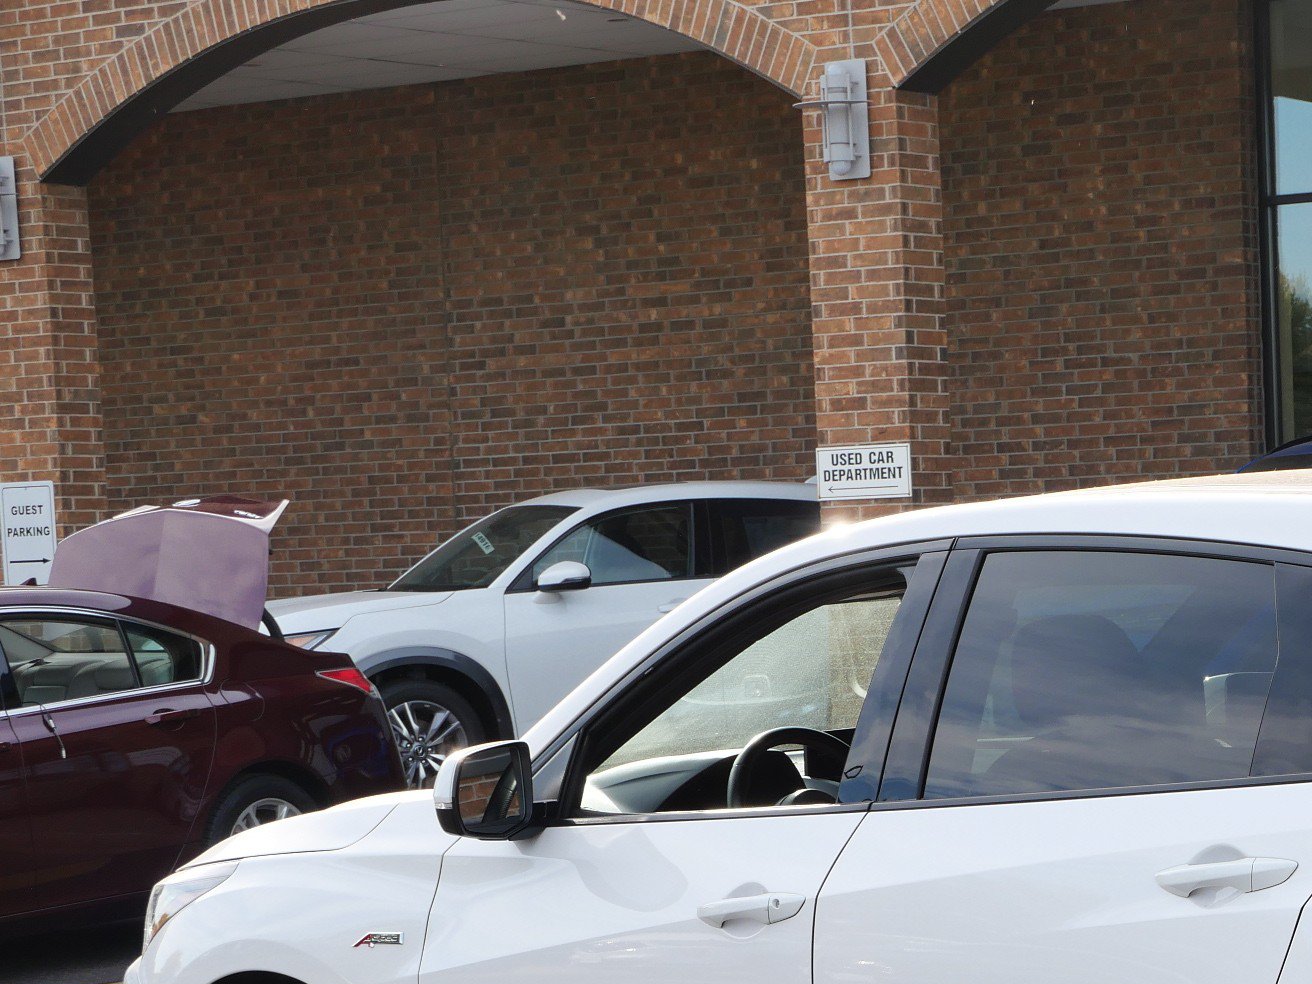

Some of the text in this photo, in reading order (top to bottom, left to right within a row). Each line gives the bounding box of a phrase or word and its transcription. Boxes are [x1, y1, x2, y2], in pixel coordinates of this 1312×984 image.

[831, 450, 894, 466] USED CAR
[823, 466, 903, 482] DEPARTMENT
[11, 505, 43, 515] GUEST
[7, 527, 50, 537] PARKING
